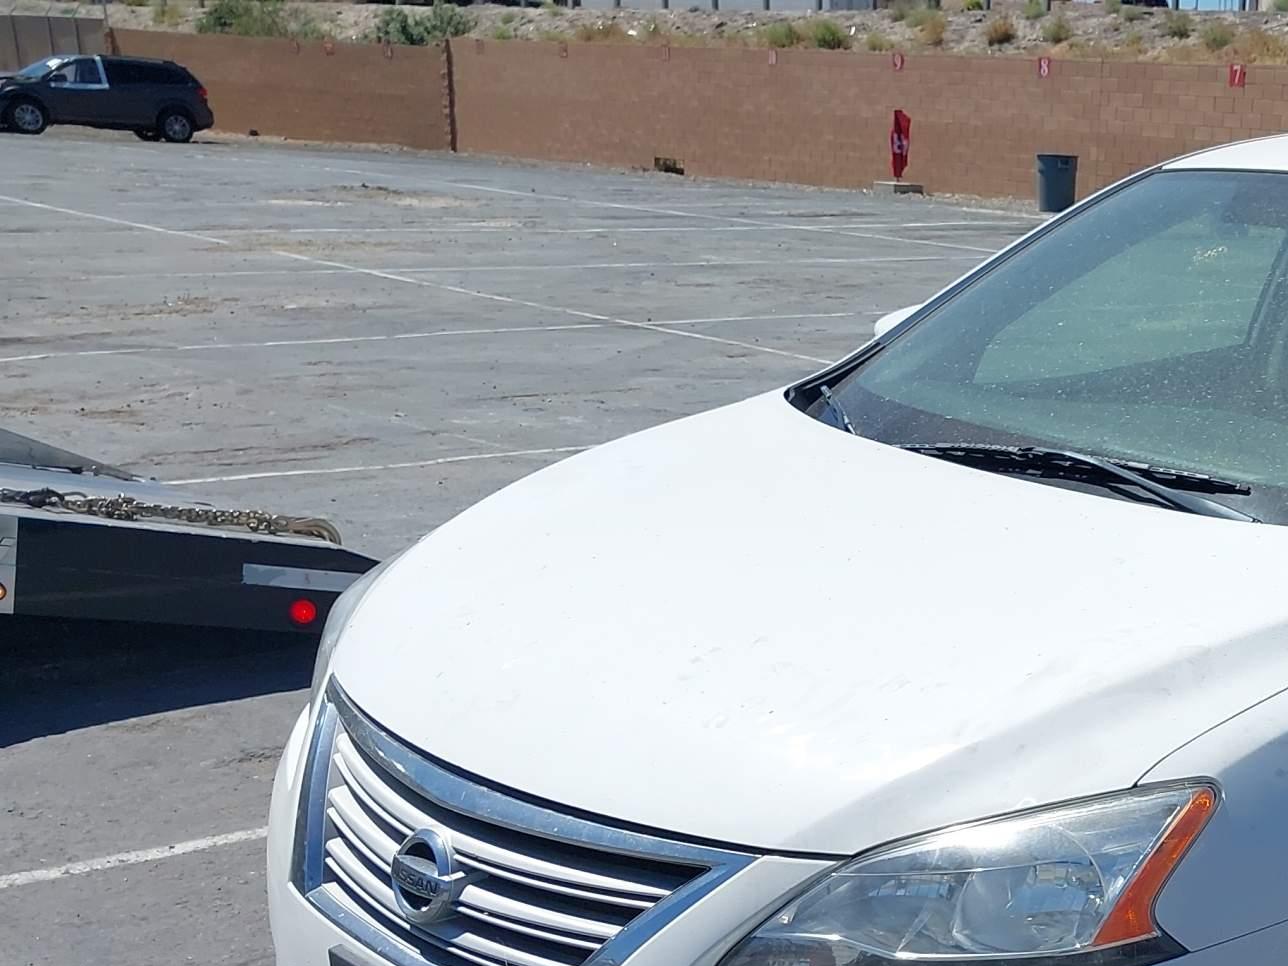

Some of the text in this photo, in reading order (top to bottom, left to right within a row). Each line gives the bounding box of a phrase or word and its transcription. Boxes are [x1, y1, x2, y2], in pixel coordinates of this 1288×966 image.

[894, 54, 902, 70] 9
[1040, 58, 1049, 77] 8
[1233, 64, 1241, 84] 7
